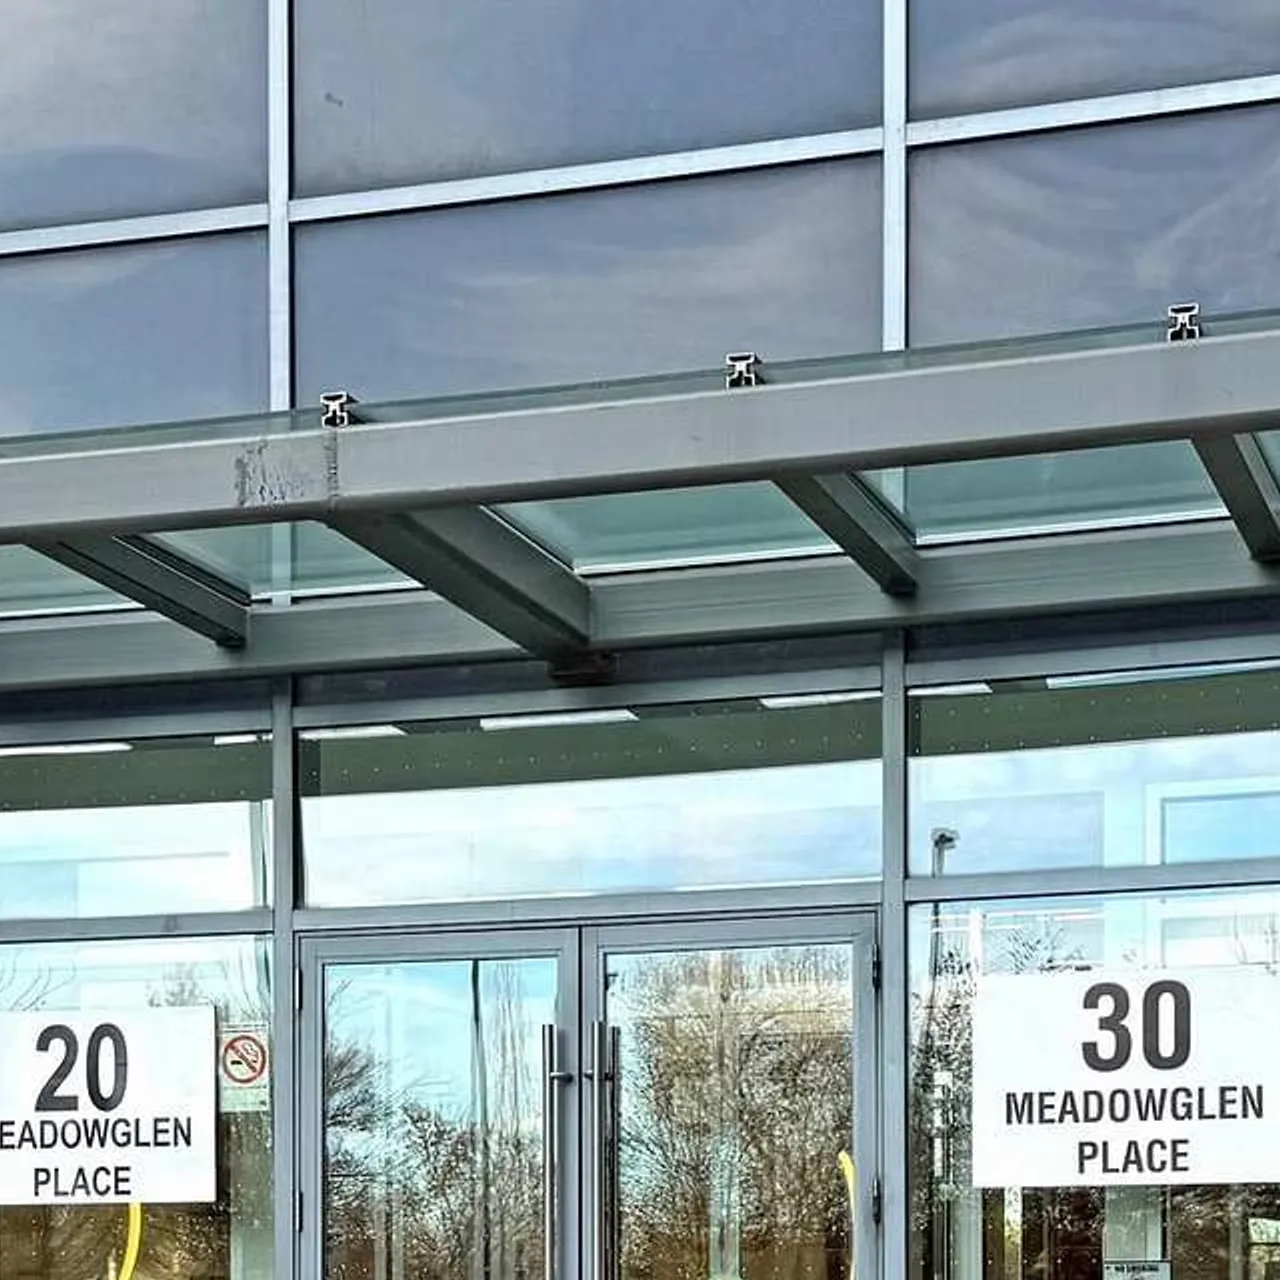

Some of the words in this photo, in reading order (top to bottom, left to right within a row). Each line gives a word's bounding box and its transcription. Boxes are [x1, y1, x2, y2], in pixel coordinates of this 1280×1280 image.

[1081, 979, 1191, 1072] 30
[34, 1023, 128, 1112] 20
[1004, 1085, 1264, 1125] MEADOWGLEN
[1077, 1138, 1190, 1174] PLACE
[33, 1166, 132, 1197] PLACE
